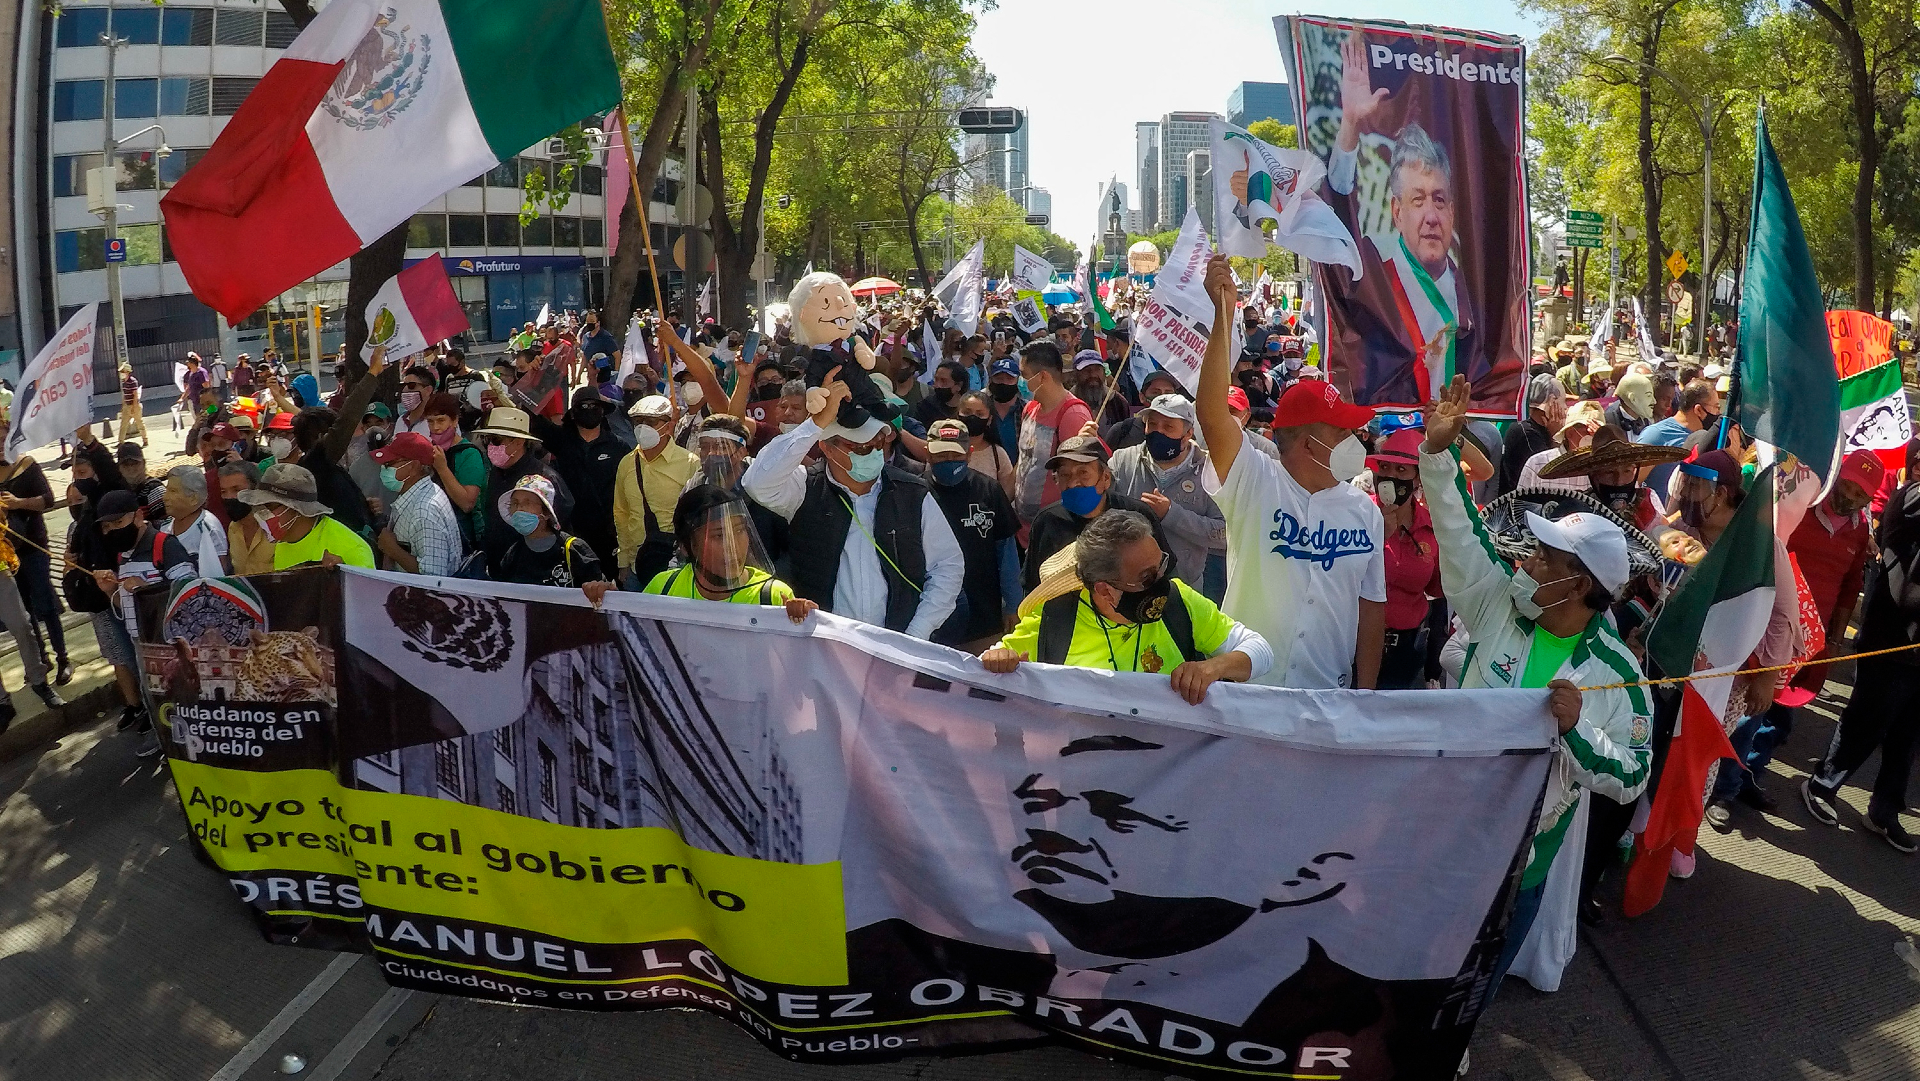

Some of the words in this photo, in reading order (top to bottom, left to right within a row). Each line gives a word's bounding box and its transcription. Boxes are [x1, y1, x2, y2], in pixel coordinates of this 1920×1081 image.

[1370, 44, 1521, 84] Presidente
[476, 260, 520, 272] Profuturo
[999, 360, 1010, 369] LA
[1893, 396, 1910, 440] AMLO
[1862, 463, 1872, 472] PT
[1270, 508, 1372, 571] Dodgers
[159, 702, 276, 727] Ciudadanos
[284, 709, 320, 723] en
[172, 715, 256, 744] Defensa
[262, 724, 303, 741] del
[185, 735, 264, 761] Pueblo
[188, 786, 304, 825] Apoyo
[413, 828, 461, 856] al
[480, 841, 746, 912] gobierno
[194, 818, 227, 849] del
[364, 914, 613, 974] MANUEL
[910, 978, 1352, 1069] OBRADOR
[558, 988, 595, 1002] en
[604, 984, 733, 1012] Defensa
[739, 1009, 772, 1041] del
[782, 1033, 920, 1053] Pueblo-
